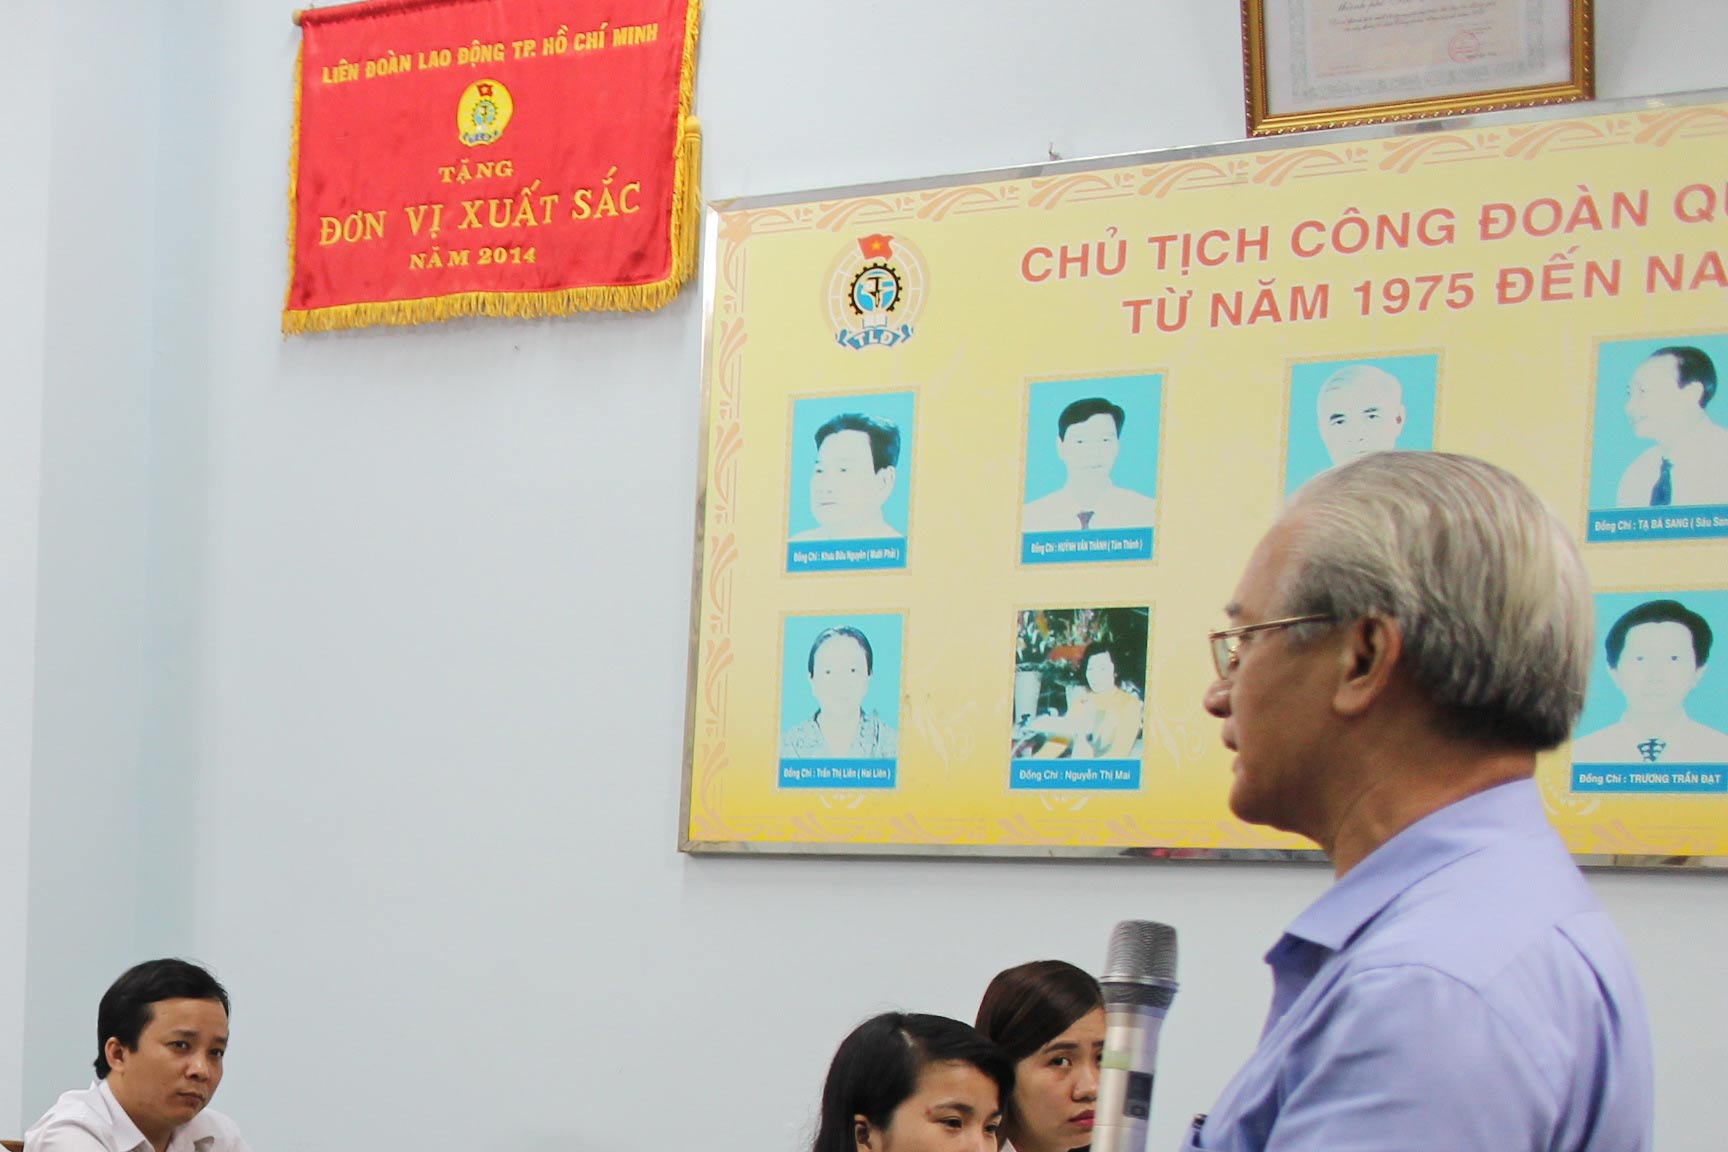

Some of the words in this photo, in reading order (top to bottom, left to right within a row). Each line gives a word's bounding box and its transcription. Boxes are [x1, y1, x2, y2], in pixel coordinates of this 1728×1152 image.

[322, 58, 359, 84] LIÊN
[365, 50, 412, 79] ĐOÀN
[418, 49, 452, 70] LAO
[457, 39, 505, 68] ĐỘNG
[512, 39, 537, 60] TP.
[542, 24, 568, 56] HỒ
[574, 21, 606, 51] CHÍ
[612, 23, 659, 47] MINH
[438, 158, 513, 184] TẶNG
[319, 210, 387, 245] ĐƠN
[404, 204, 444, 239] VỊ
[458, 179, 559, 229] XUẤT
[572, 166, 641, 220] SẮC
[1021, 226, 1127, 282] CHỦ
[1148, 225, 1270, 276] TỊCH
[1291, 207, 1456, 258] CÔNG
[1478, 184, 1649, 241] ĐOÀN
[1674, 182, 1728, 224] Q
[409, 246, 470, 269] NĂM
[477, 247, 537, 265] 2014
[1122, 287, 1193, 334] TỪ
[1210, 278, 1330, 328] NĂM
[1353, 272, 1475, 314] 1975
[1496, 245, 1621, 305] ĐẾN
[1665, 518, 1689, 529] SANG
[1019, 769, 1042, 781] Đồng
[1064, 768, 1098, 781] Nguyễn
[1100, 769, 1113, 781] Thị
[1115, 770, 1131, 780] Mai
[1579, 773, 1604, 785] Đồng
[1672, 771, 1699, 783] TRẦN
[1700, 773, 1722, 785] ĐẠT
